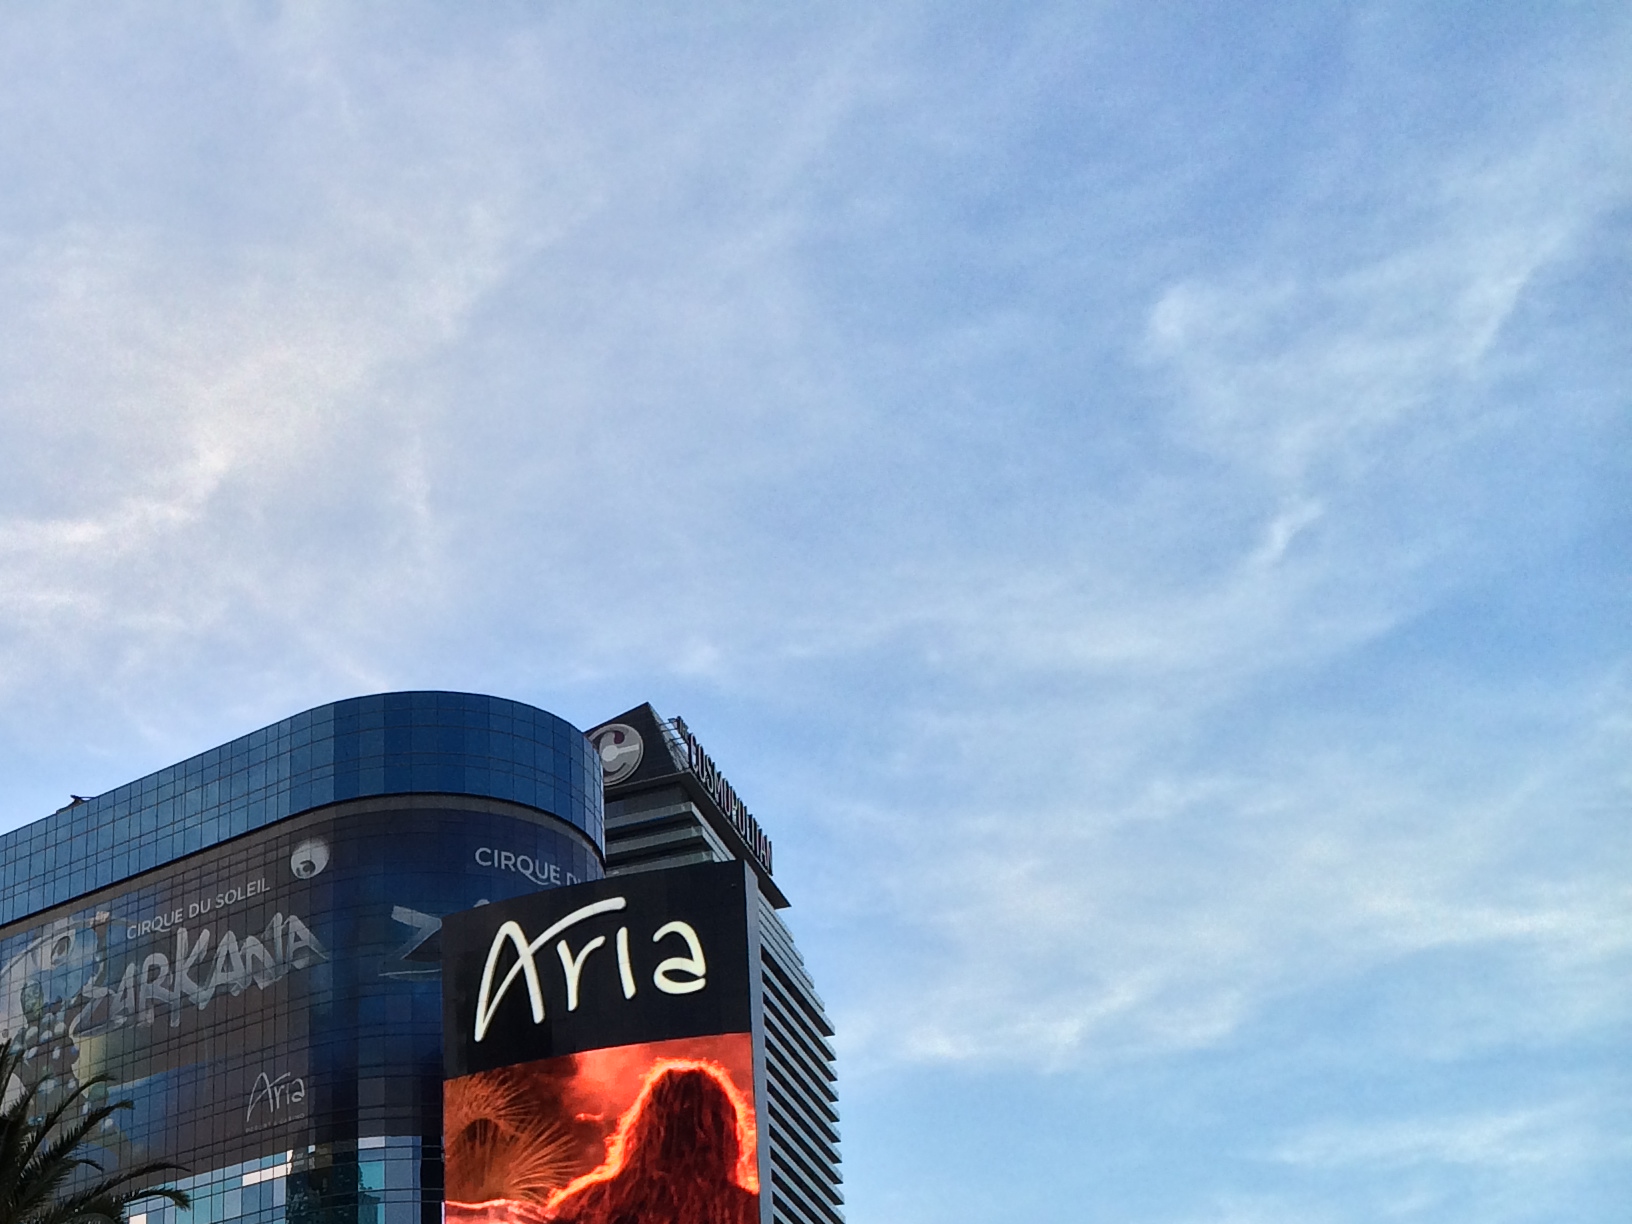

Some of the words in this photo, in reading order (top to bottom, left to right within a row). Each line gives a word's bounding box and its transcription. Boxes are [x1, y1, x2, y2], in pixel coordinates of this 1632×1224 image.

[474, 847, 562, 887] CIRQUE
[126, 910, 185, 940] CIRQUE
[188, 899, 212, 919] DU
[214, 878, 271, 909] SOLEIL
[474, 896, 707, 1042] Aria
[246, 1071, 305, 1123] Aria
